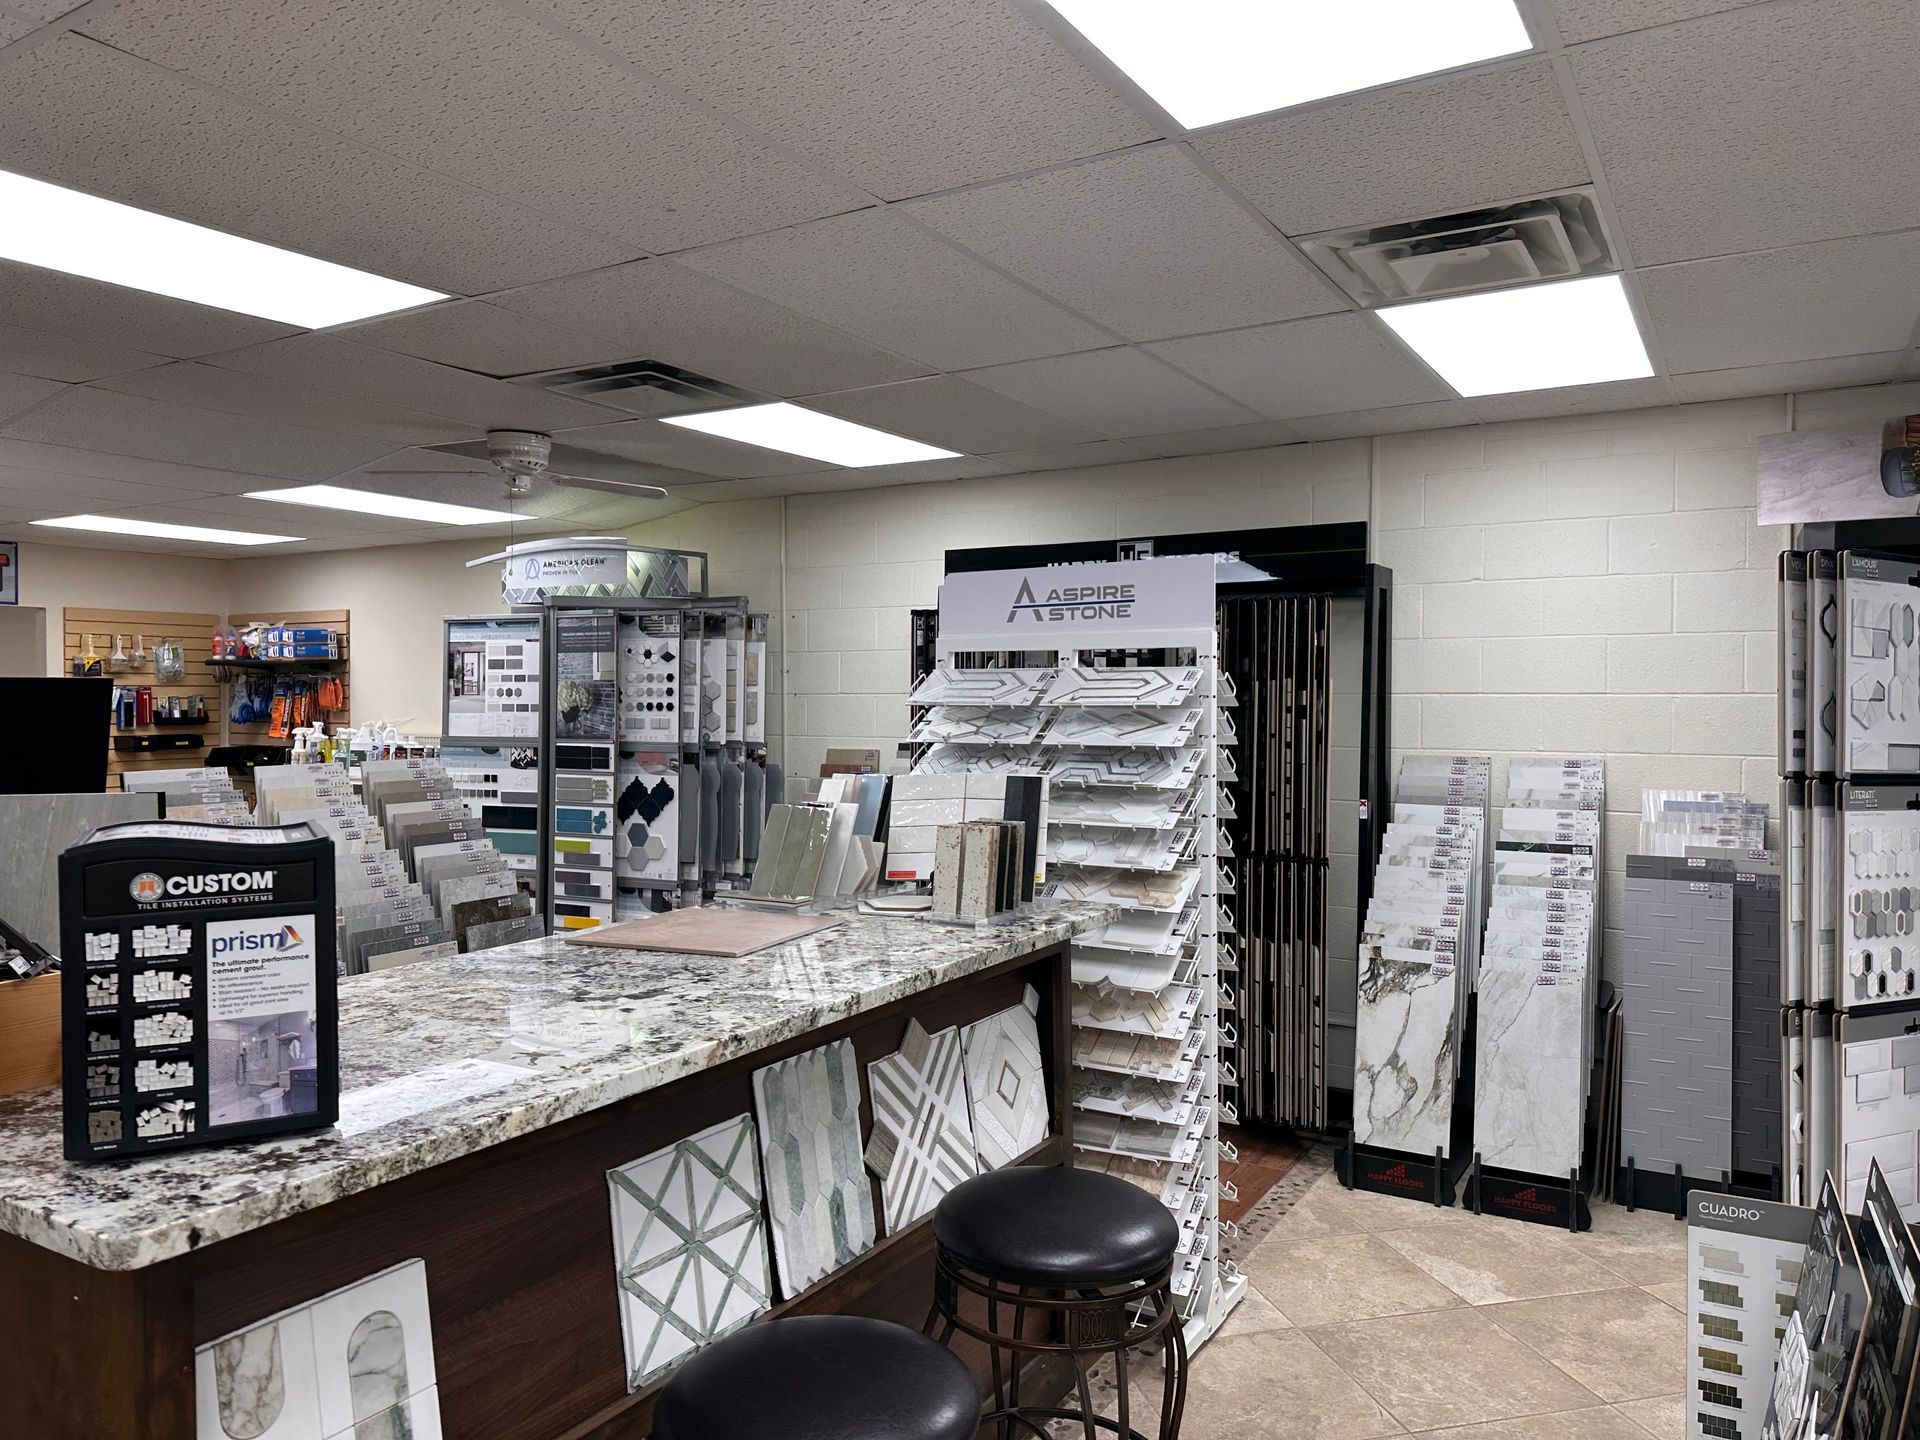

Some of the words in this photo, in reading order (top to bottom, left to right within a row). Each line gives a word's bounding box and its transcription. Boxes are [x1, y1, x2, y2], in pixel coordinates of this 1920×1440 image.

[543, 560, 579, 568] AMERICAN
[581, 558, 605, 566] OLEAN
[1046, 584, 1135, 602] ASPIRE
[1049, 604, 1131, 621] STONE
[166, 871, 273, 895] CUSTOM
[161, 897, 228, 909] INSTALLATION
[231, 894, 273, 904] SYSTEMS
[212, 930, 284, 958] prism
[228, 958, 259, 967] ultimate
[261, 954, 309, 964] performance
[212, 966, 242, 975] cement
[1367, 1171, 1394, 1184] HAPPY
[1394, 1177, 1424, 1189] FLOORS
[1494, 1195, 1523, 1208] HAPPY
[1523, 1200, 1557, 1213] FLOORS
[1699, 1202, 1760, 1220] CUADRO
